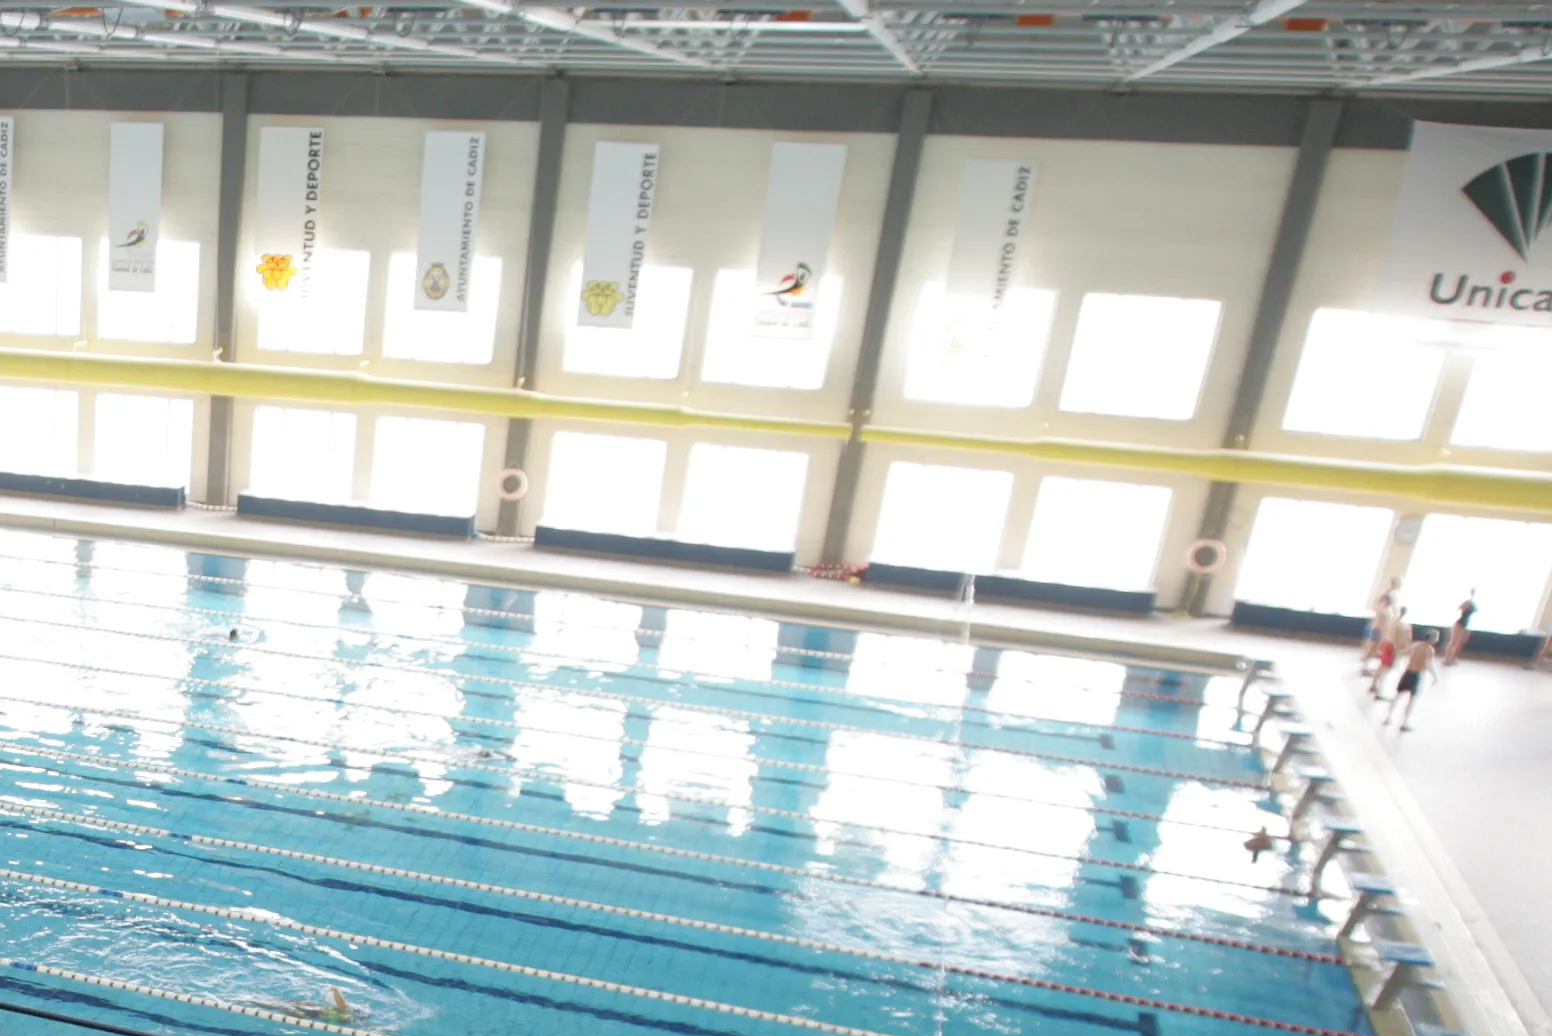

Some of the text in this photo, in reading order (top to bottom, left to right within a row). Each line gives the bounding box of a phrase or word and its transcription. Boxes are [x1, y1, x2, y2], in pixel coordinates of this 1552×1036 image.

[0, 121, 9, 158] CADIZ
[0, 162, 8, 176] DE
[306, 131, 322, 201] DEPORTE
[305, 205, 317, 215] Y
[1011, 165, 1033, 213] CADIZ
[456, 136, 480, 302] AYUNTAMIENTO DE CADIZ
[625, 153, 657, 316] JUVENTUD Y DEPORTE
[1007, 218, 1021, 237] DE
[1430, 269, 1552, 313] Unica
